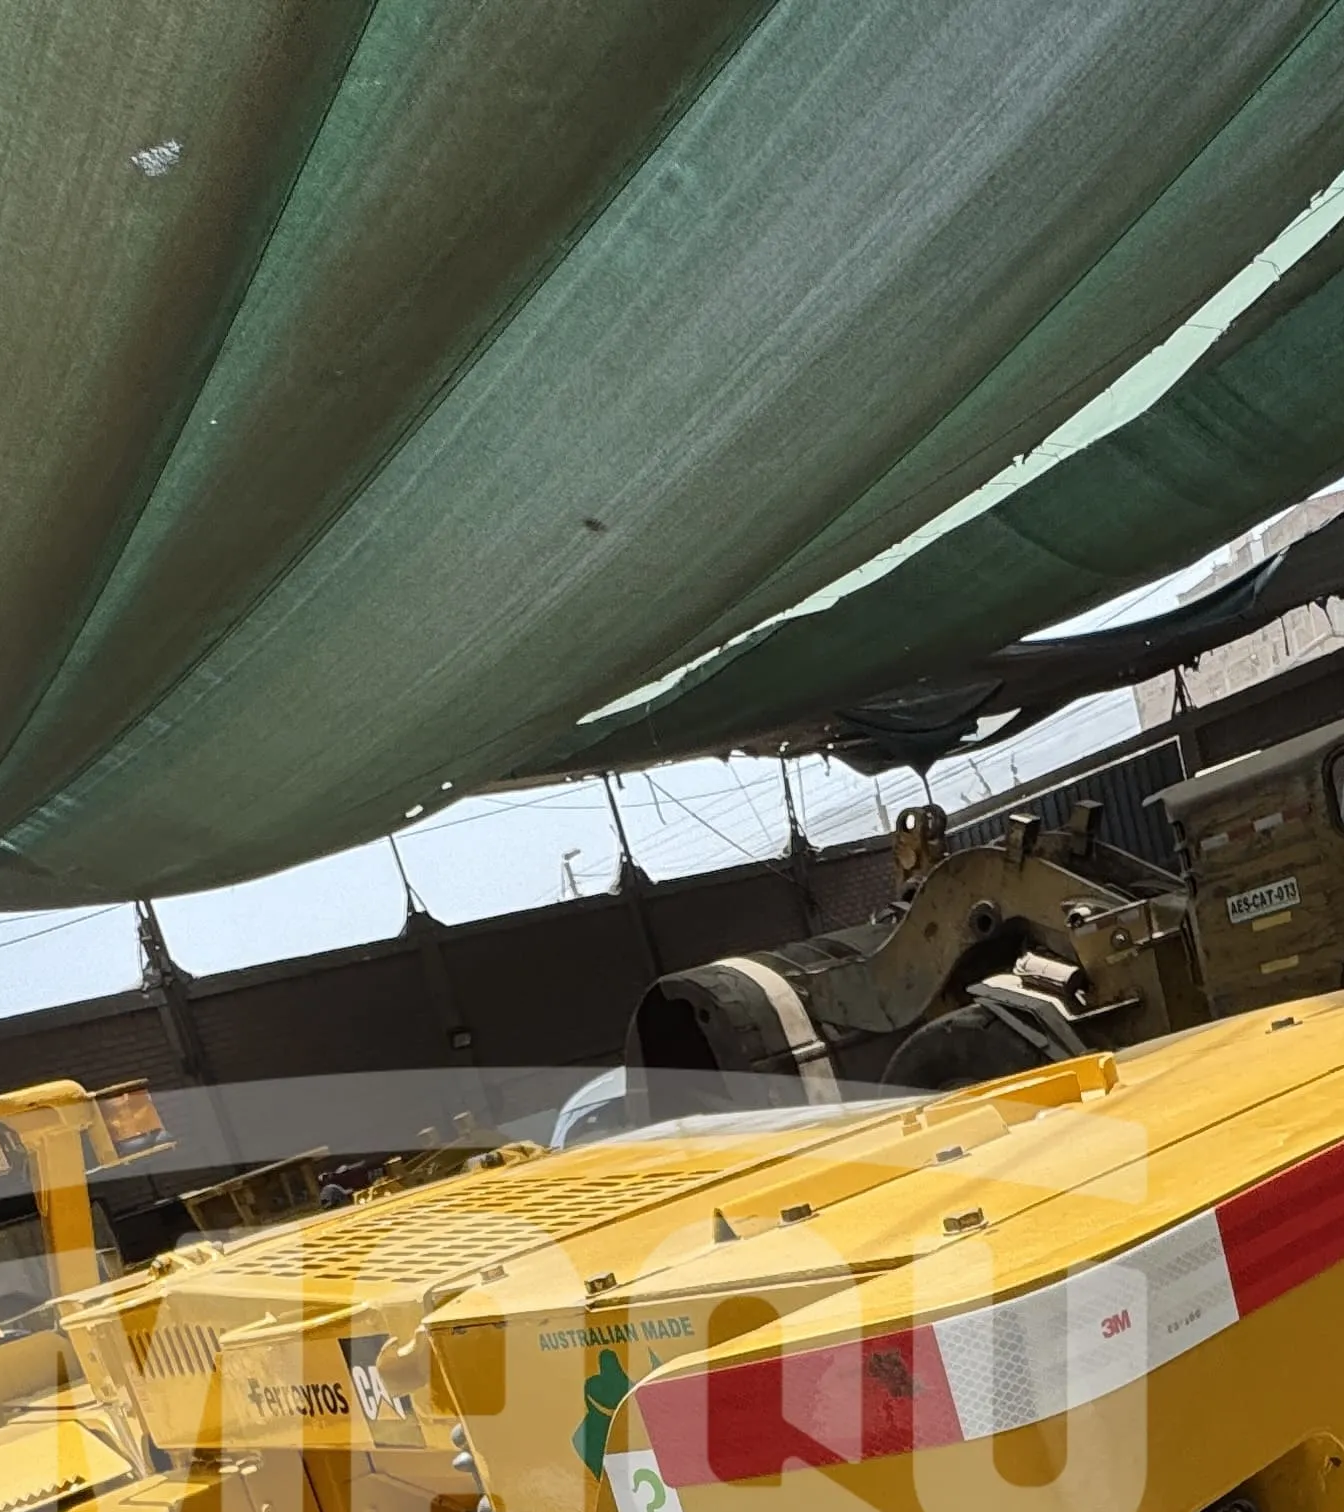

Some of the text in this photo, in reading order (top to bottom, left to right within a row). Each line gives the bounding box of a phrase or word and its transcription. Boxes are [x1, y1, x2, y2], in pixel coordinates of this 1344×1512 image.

[538, 1315, 696, 1352] AUSTRALIAN MADE
[1100, 1309, 1132, 1339] 3M
